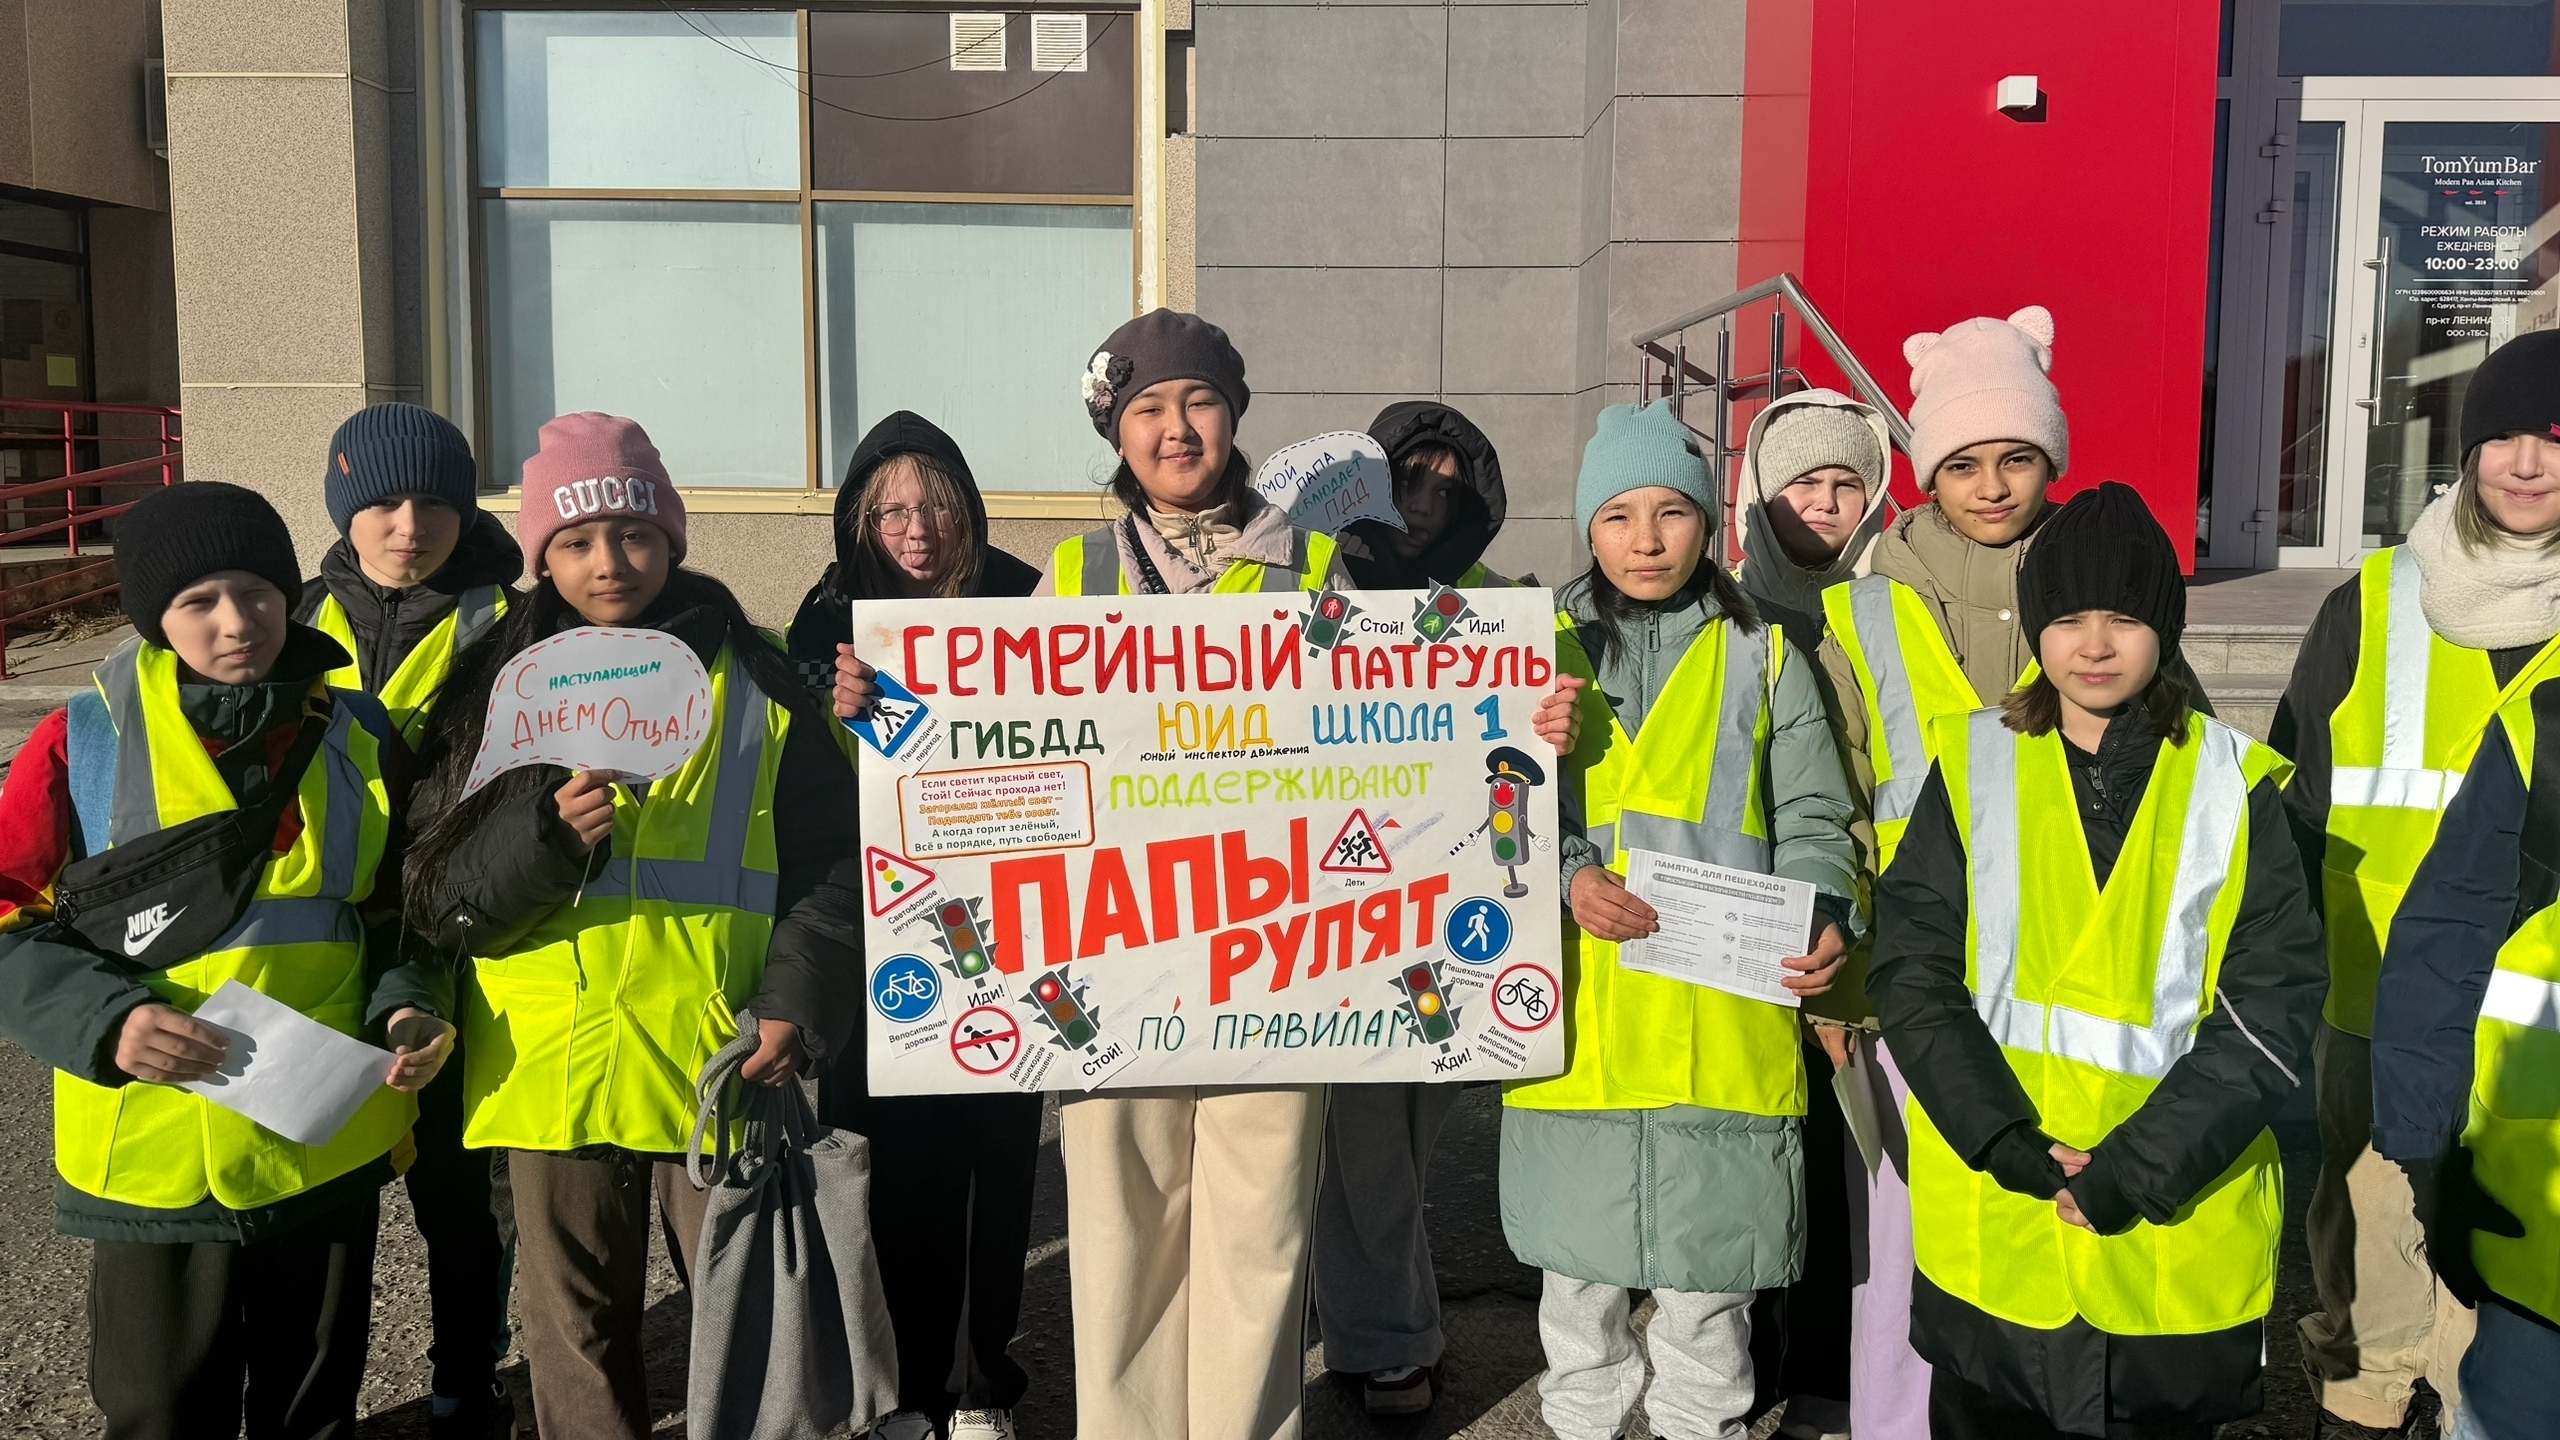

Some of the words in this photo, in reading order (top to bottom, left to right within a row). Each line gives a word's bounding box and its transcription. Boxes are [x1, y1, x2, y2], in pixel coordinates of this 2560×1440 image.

[2421, 156, 2538, 175] TomYumBar
[2434, 178, 2460, 186] Modern
[2461, 178, 2474, 186] Pan
[2475, 178, 2495, 186] Asian
[2496, 178, 2522, 186] Kitchen
[2421, 226, 2470, 237] РЕЖИМ
[2474, 226, 2527, 237] РАБОТЫ
[2436, 241, 2508, 252] ЕЖЕДНЕВНО
[2426, 317, 2451, 326] пр-кт
[2446, 329, 2465, 337] ООО
[2466, 329, 2489, 337] «ТБС»
[1262, 458, 1297, 498] МОЙ
[1296, 451, 1336, 493] ПАПА
[553, 476, 658, 520] GUCCI
[1288, 457, 1362, 521] СОБЛЮДАЕТ
[1324, 477, 1370, 523] ПДД
[1359, 618, 1404, 636] Стой!
[1468, 618, 1506, 634] Иди!
[515, 663, 538, 700] С
[549, 660, 662, 691] НАСТУПАЮЩИМ
[1331, 643, 1552, 690] ПАТРУЛЬ
[510, 699, 596, 751] ДНЁМ
[949, 718, 1105, 760] ГИБДД
[1157, 700, 1274, 752] ЮИД
[1311, 701, 1454, 746] ШКОЛА
[1472, 694, 1509, 742] 1
[899, 717, 939, 765] Пешеходный
[915, 732, 942, 763] переход
[921, 779, 947, 790] Если
[949, 777, 985, 788] светит
[987, 772, 1035, 786] красный
[1038, 770, 1064, 780] свет,
[921, 790, 951, 802] Стой!
[954, 788, 992, 799] Сейчас
[995, 785, 1041, 798] прохода
[1044, 782, 1066, 793] нет!
[1110, 761, 1433, 808] ПОДДЕРЖИВАЮТ
[919, 802, 978, 815] Загорелся
[980, 796, 1026, 809] жёлтый
[1028, 796, 1053, 805] свет
[927, 812, 994, 827] Подождать
[996, 809, 1022, 820] тебе
[1025, 807, 1060, 818] совет.
[914, 841, 934, 852] Всё
[937, 842, 943, 850] в
[946, 837, 996, 850] порядке,
[999, 835, 1023, 847] путь
[1025, 830, 1081, 844] свободен!
[931, 828, 940, 838] А
[942, 826, 973, 838] когда
[976, 824, 1007, 836] горит
[1009, 820, 1060, 832] зелёный,
[1344, 877, 1366, 888] Дети
[1654, 859, 1699, 875] ПАМЯТКА
[1701, 869, 1722, 880] ДЛЯ
[1724, 874, 1786, 893] ПЕШЕХОДОВ
[127, 902, 169, 939] NIKE
[887, 889, 938, 926] Светофорное
[892, 896, 947, 935] регулирование
[989, 816, 1310, 976] ПАПЫ
[1208, 873, 1450, 1007] РУЛЯТ
[1444, 963, 1495, 981] Пешеходная
[1450, 976, 1484, 989] дорожка
[967, 984, 1006, 1009] Иди!
[888, 1018, 948, 1044] Велосипедная
[903, 1033, 939, 1051] дорожка
[1137, 1012, 1186, 1052] ПО
[1212, 1010, 1417, 1050] ПРАВИЛАМ
[1487, 1025, 1527, 1051] Движение
[1009, 1043, 1035, 1081] Движение
[1081, 1042, 1123, 1078] Стой!
[1431, 1047, 1473, 1074] Жди!
[1476, 1044, 1519, 1070] запрещено
[1478, 1033, 1527, 1063] велосипедов
[1018, 1046, 1046, 1088] пешеходов
[1027, 1051, 1055, 1092] запрещено
